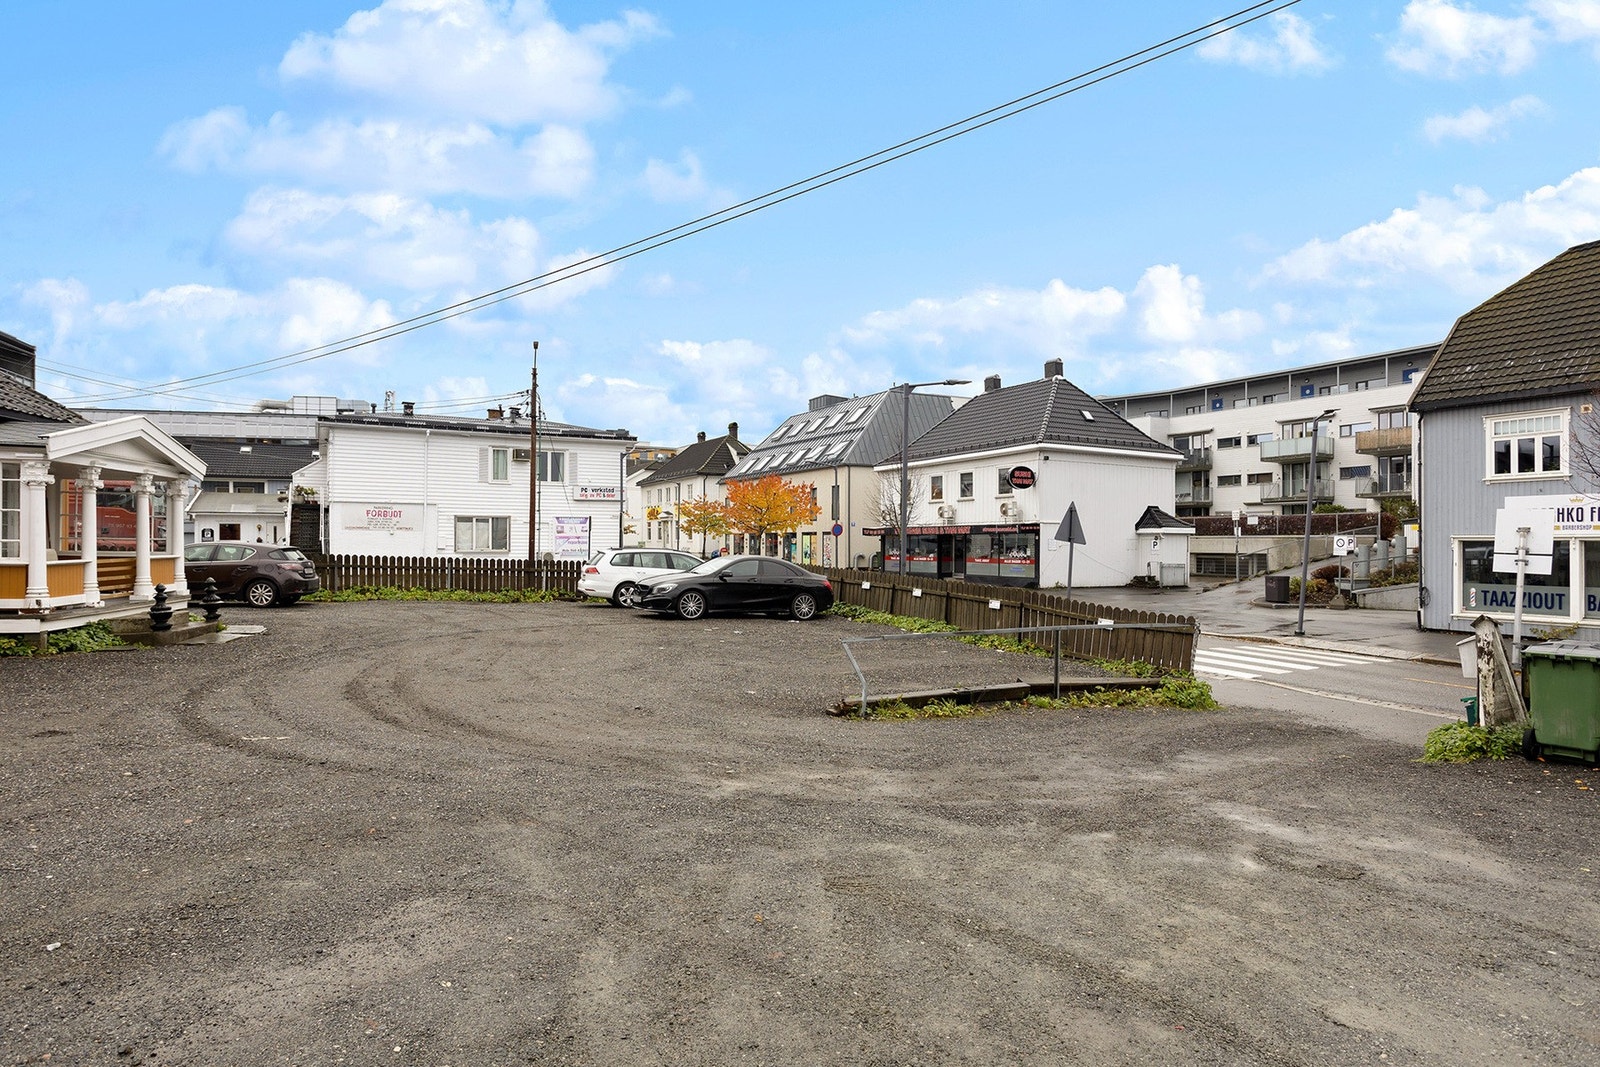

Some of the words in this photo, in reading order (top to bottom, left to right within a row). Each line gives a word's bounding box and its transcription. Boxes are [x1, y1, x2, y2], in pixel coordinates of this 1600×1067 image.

[366, 510, 403, 518] FORBUDT
[1553, 507, 1584, 523] HKO
[1152, 541, 1158, 549] P
[1348, 538, 1354, 546] P
